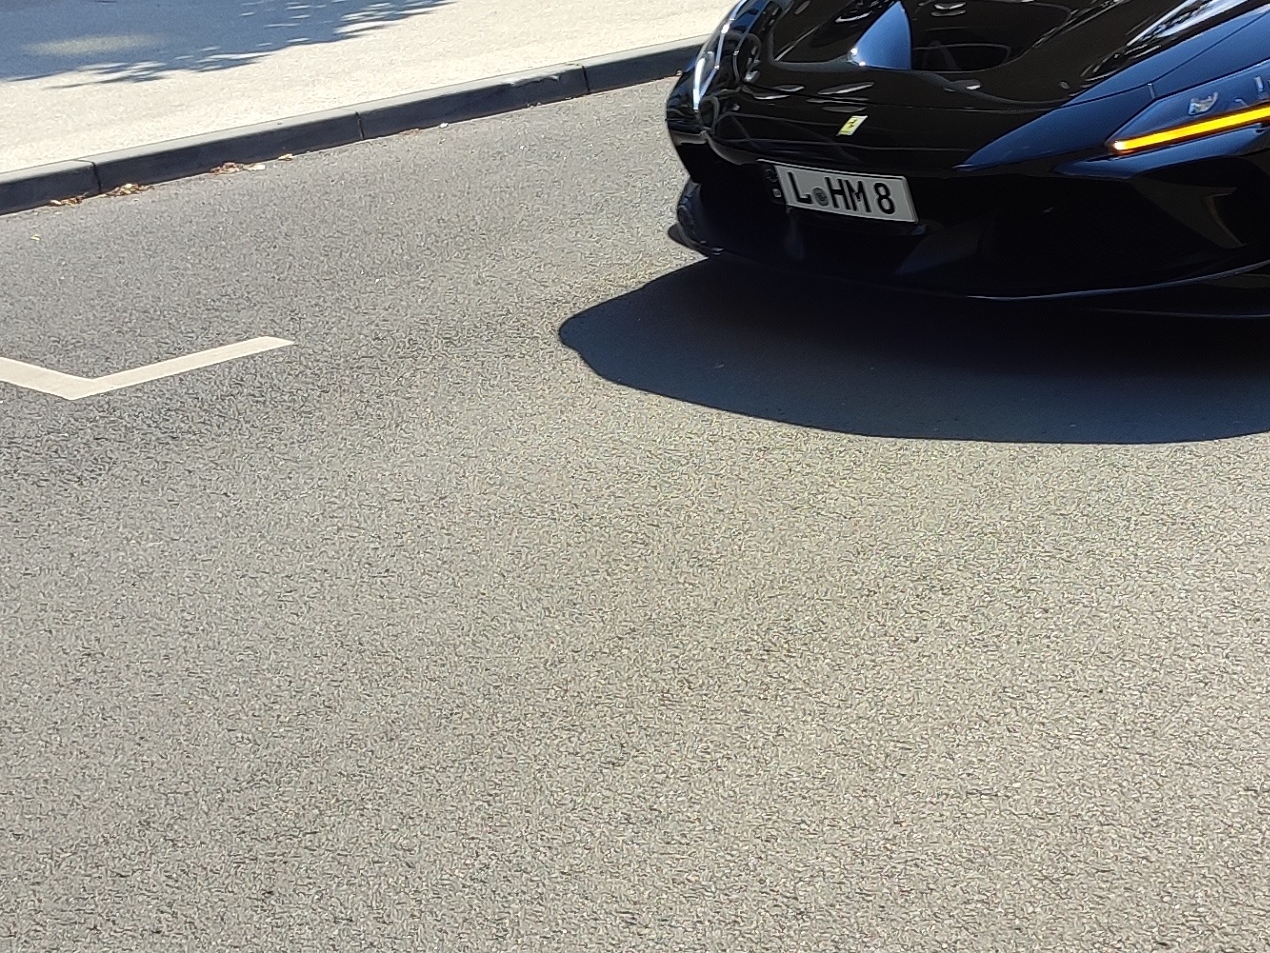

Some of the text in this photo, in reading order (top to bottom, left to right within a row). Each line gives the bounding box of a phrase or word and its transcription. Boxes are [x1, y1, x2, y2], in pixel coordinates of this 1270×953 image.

[787, 171, 896, 215] L HM 8
